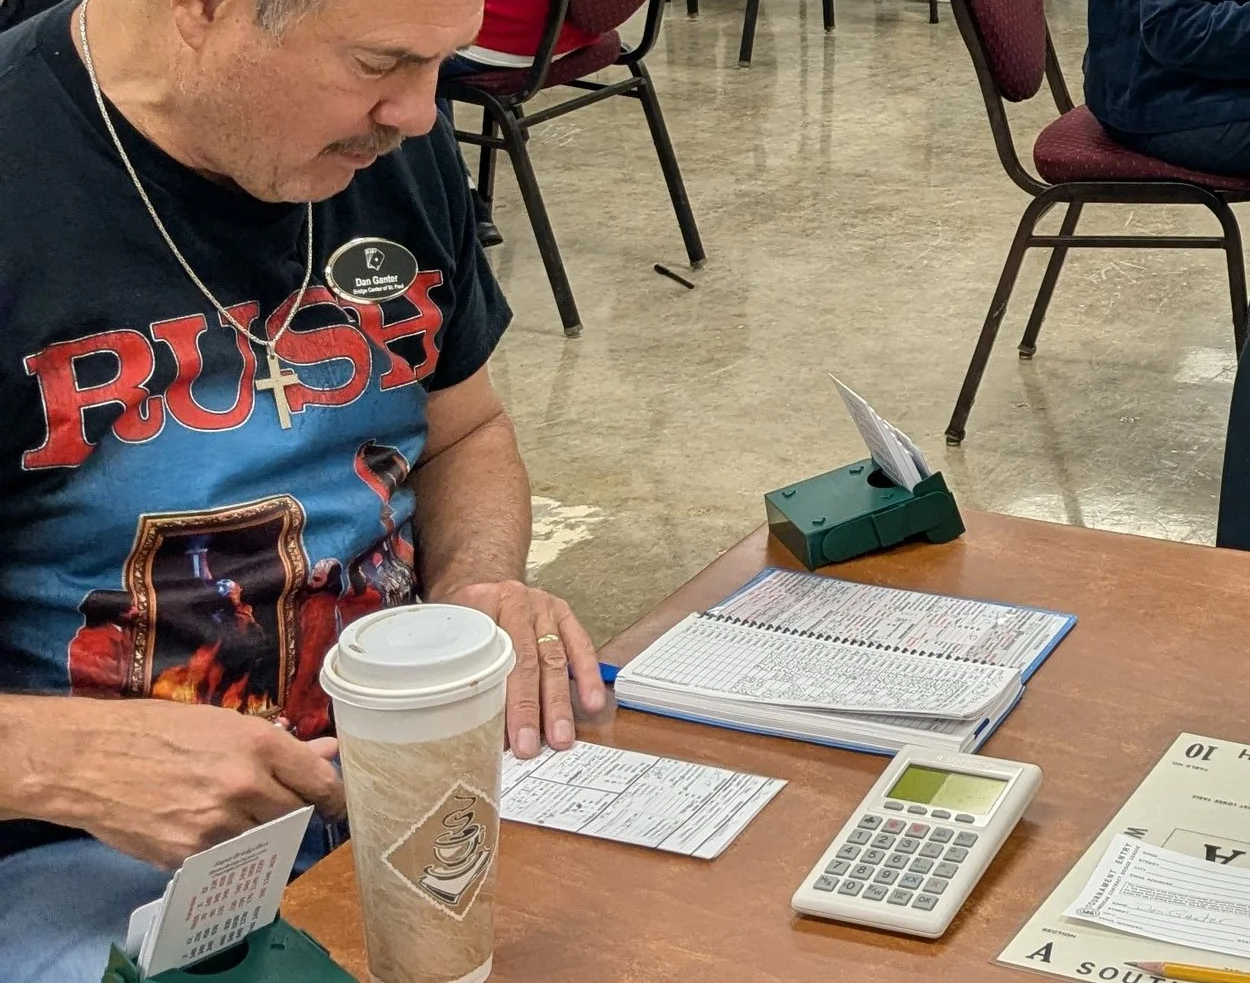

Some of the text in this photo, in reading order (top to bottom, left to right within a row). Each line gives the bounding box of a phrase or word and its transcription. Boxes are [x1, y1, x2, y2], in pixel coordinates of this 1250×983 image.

[355, 275, 398, 286] Dan Ganter
[22, 270, 443, 471] RUSH
[1185, 742, 1218, 761] 10
[903, 840, 912, 848] 3
[892, 855, 901, 863] 6
[834, 861, 843, 869] 7
[857, 866, 866, 874] 8
[882, 870, 891, 879] 9
[1086, 869, 1117, 909] TOURNAMENT
[1115, 842, 1132, 864] ENTRY
[919, 896, 932, 904] OK
[1041, 927, 1077, 939] SECTION
[1025, 941, 1054, 963] A
[1076, 961, 1178, 983] SOUT
